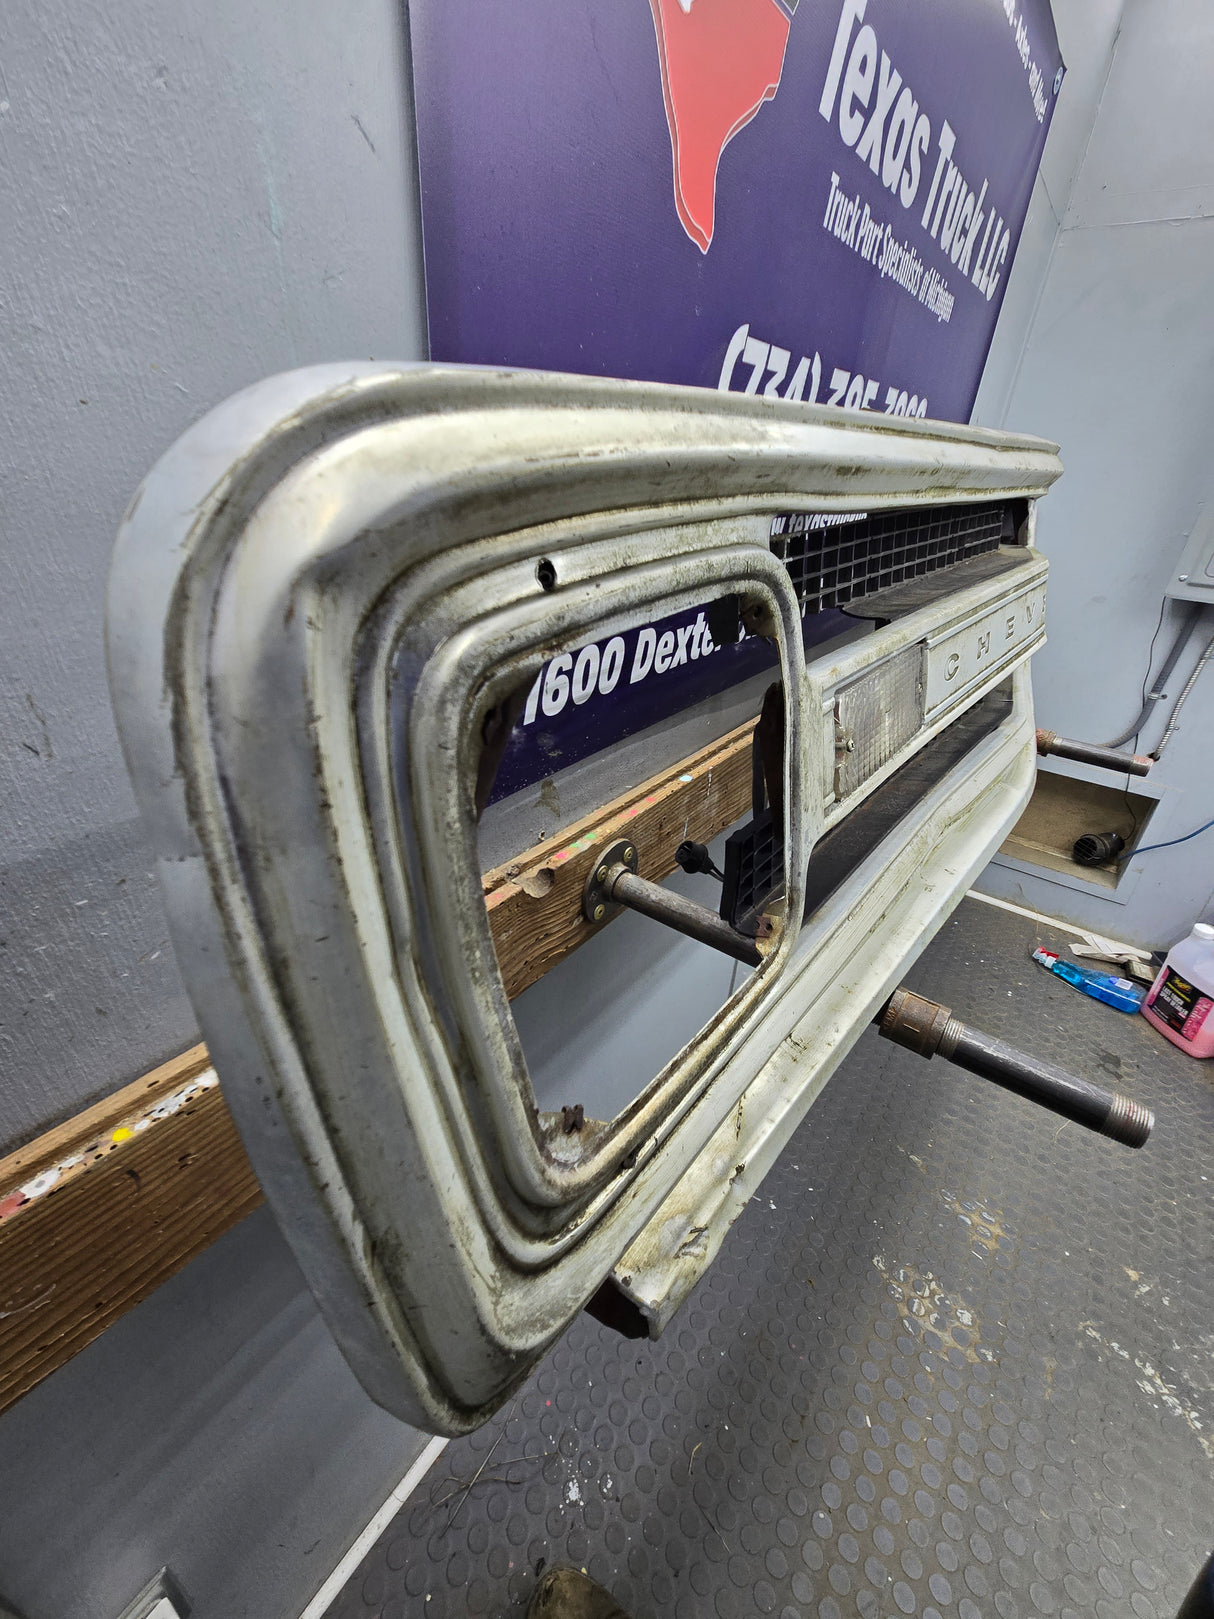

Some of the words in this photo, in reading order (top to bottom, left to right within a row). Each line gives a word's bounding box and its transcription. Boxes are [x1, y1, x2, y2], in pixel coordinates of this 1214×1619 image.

[819, 0, 931, 208] Texas
[921, 119, 986, 277] Truck
[971, 206, 1010, 301] LLC
[823, 170, 861, 249] Truck
[855, 202, 884, 266] Part
[878, 223, 924, 297] Specialists
[629, 611, 721, 685] Dexte
